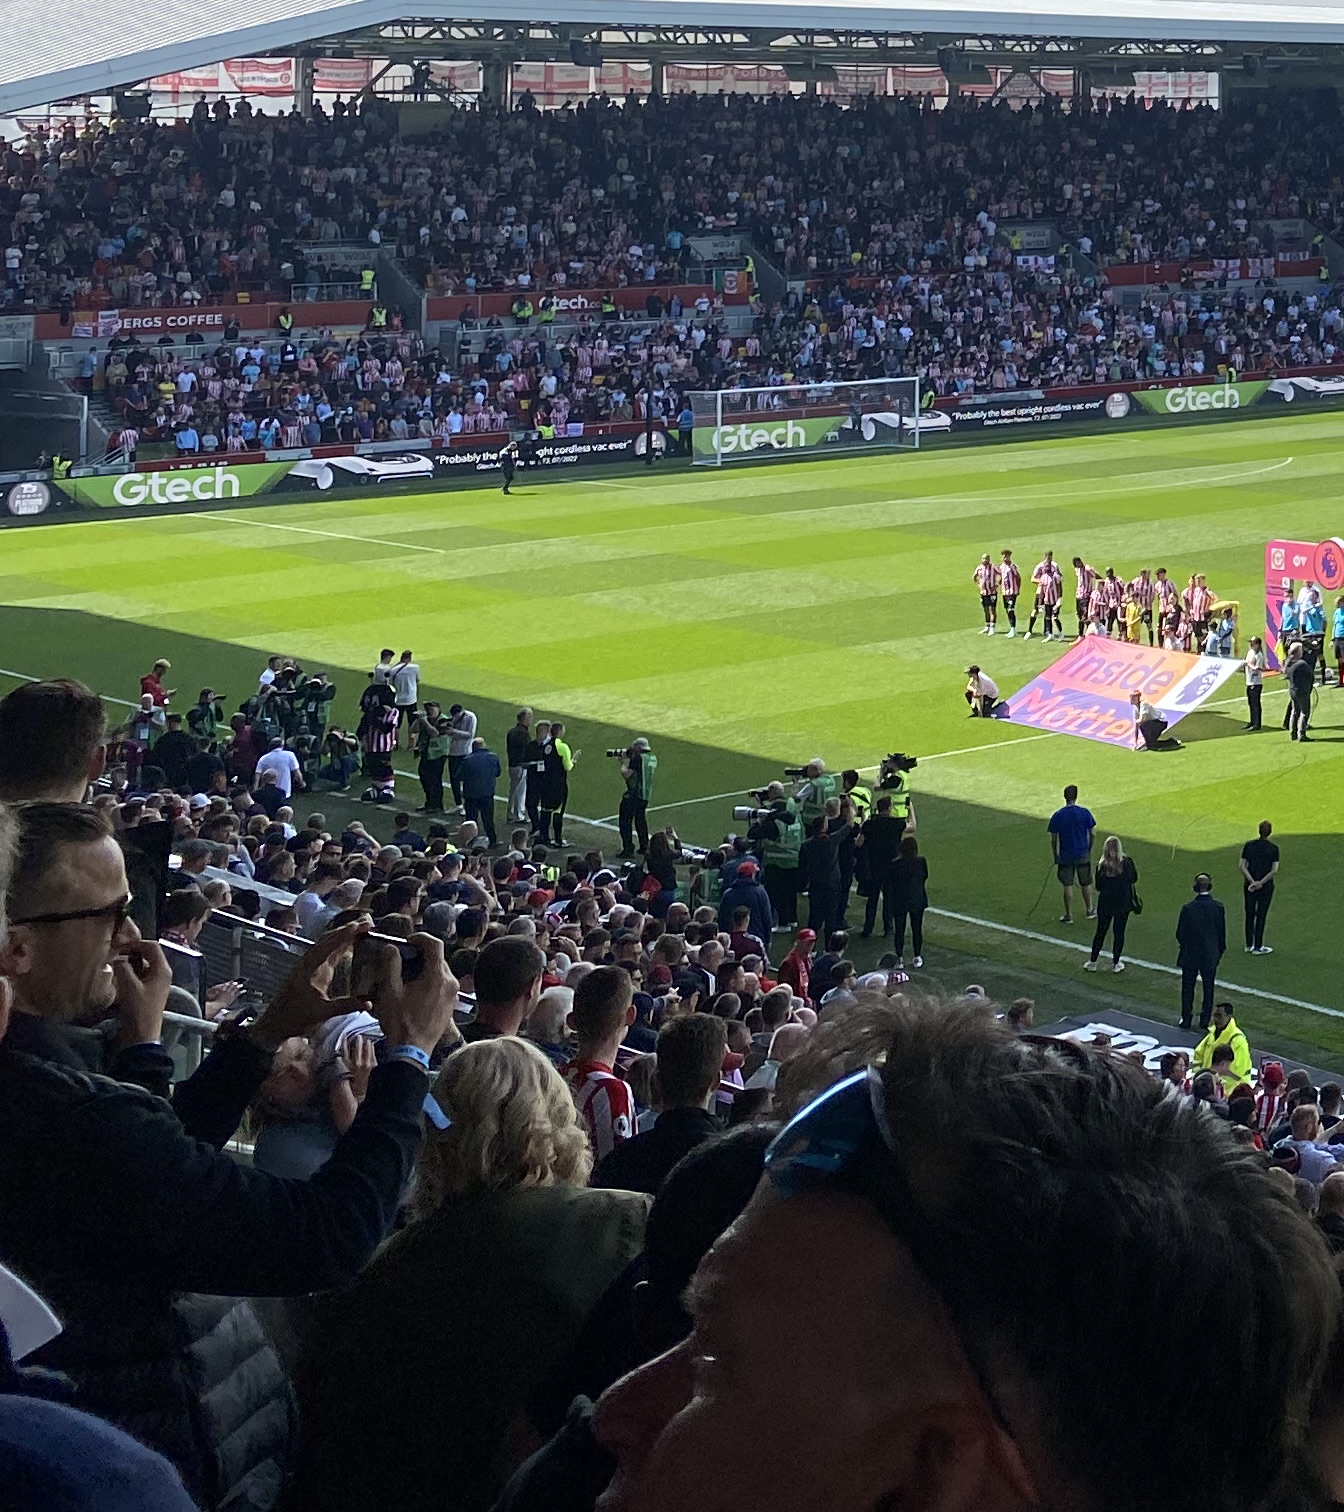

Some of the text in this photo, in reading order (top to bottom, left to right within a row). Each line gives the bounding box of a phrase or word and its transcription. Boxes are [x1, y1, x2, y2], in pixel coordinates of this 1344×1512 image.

[166, 314, 223, 327] COFFEE
[988, 409, 1000, 418] the
[1000, 407, 1017, 416] best
[1165, 384, 1240, 413] Gtech
[482, 451, 499, 461] the
[554, 444, 591, 454] cordless
[592, 443, 608, 452] vac
[712, 420, 807, 454] Gtech
[113, 466, 240, 507] Gtech
[1058, 645, 1175, 697] Inside
[1009, 686, 1139, 748] Matter
